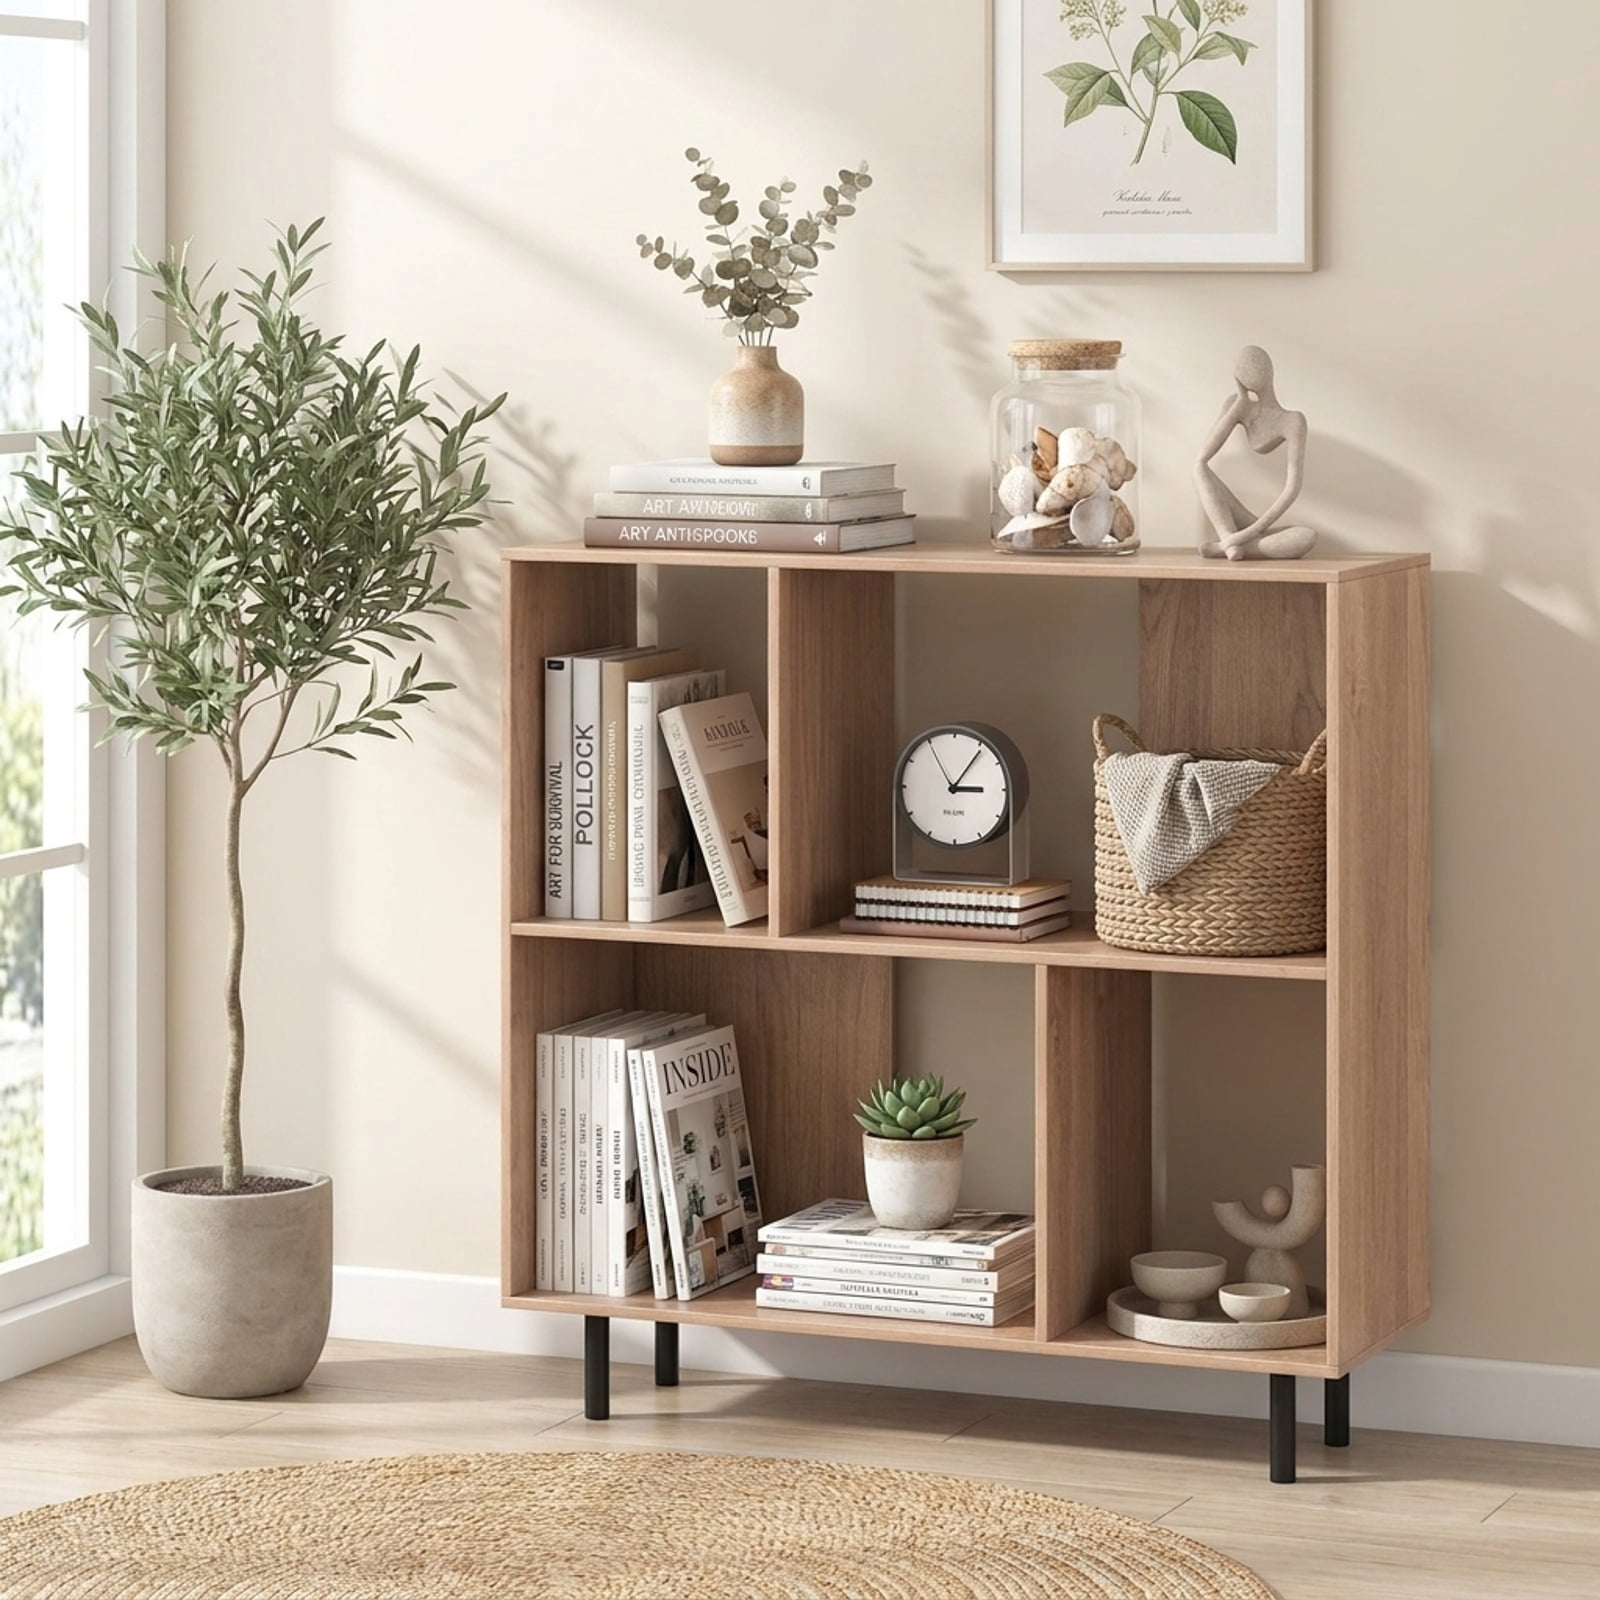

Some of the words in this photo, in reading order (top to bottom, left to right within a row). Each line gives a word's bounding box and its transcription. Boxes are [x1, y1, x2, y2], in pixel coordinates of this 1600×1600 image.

[642, 498, 673, 514] ART
[575, 723, 595, 846] POLLOCK
[548, 834, 562, 867] FOR
[662, 1042, 736, 1096] INSIDE
